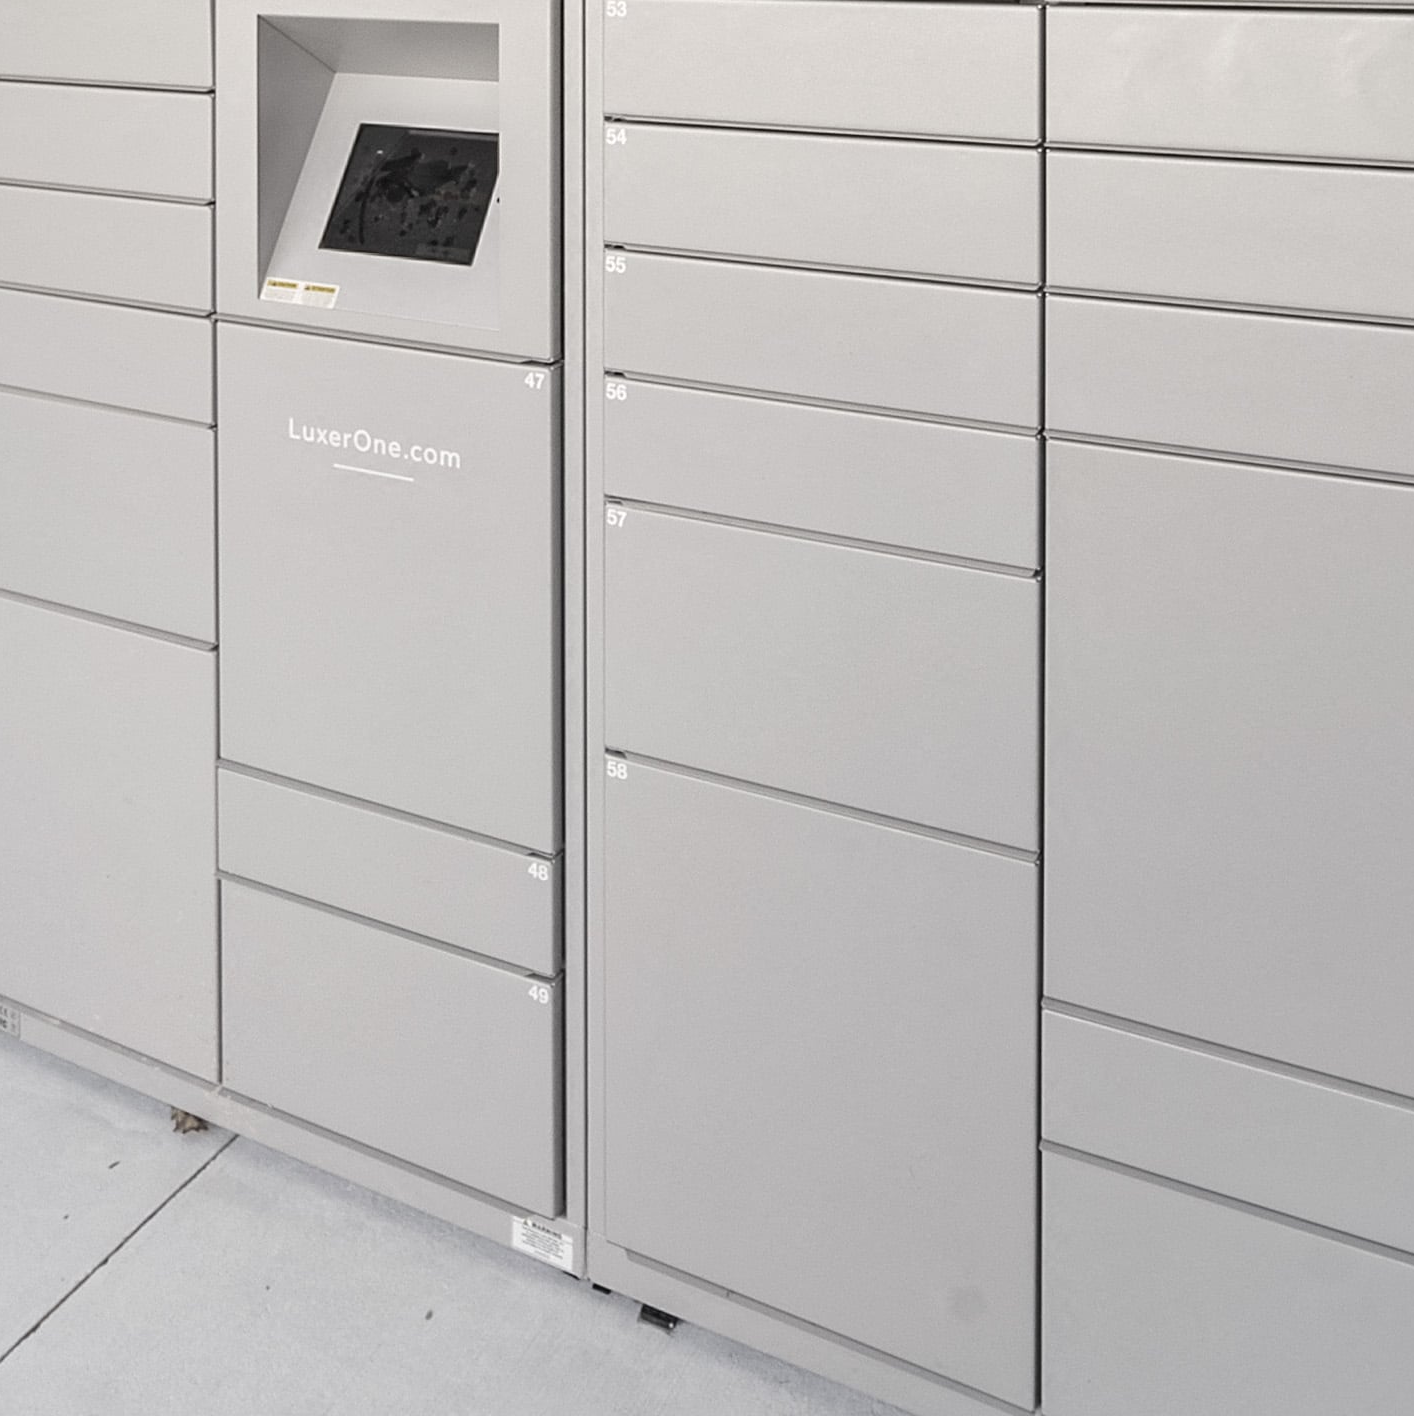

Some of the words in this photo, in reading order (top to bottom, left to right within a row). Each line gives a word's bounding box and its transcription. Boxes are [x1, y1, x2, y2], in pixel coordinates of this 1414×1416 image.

[606, 1, 627, 17] 53
[606, 128, 627, 145] 54
[605, 256, 626, 273] 55
[524, 372, 545, 390] 47
[606, 383, 627, 400] 56
[288, 417, 462, 469] LuxerOne.com
[606, 509, 627, 528] 57
[606, 761, 627, 780] 58
[527, 862, 549, 881] 48
[528, 985, 549, 1004] 49
